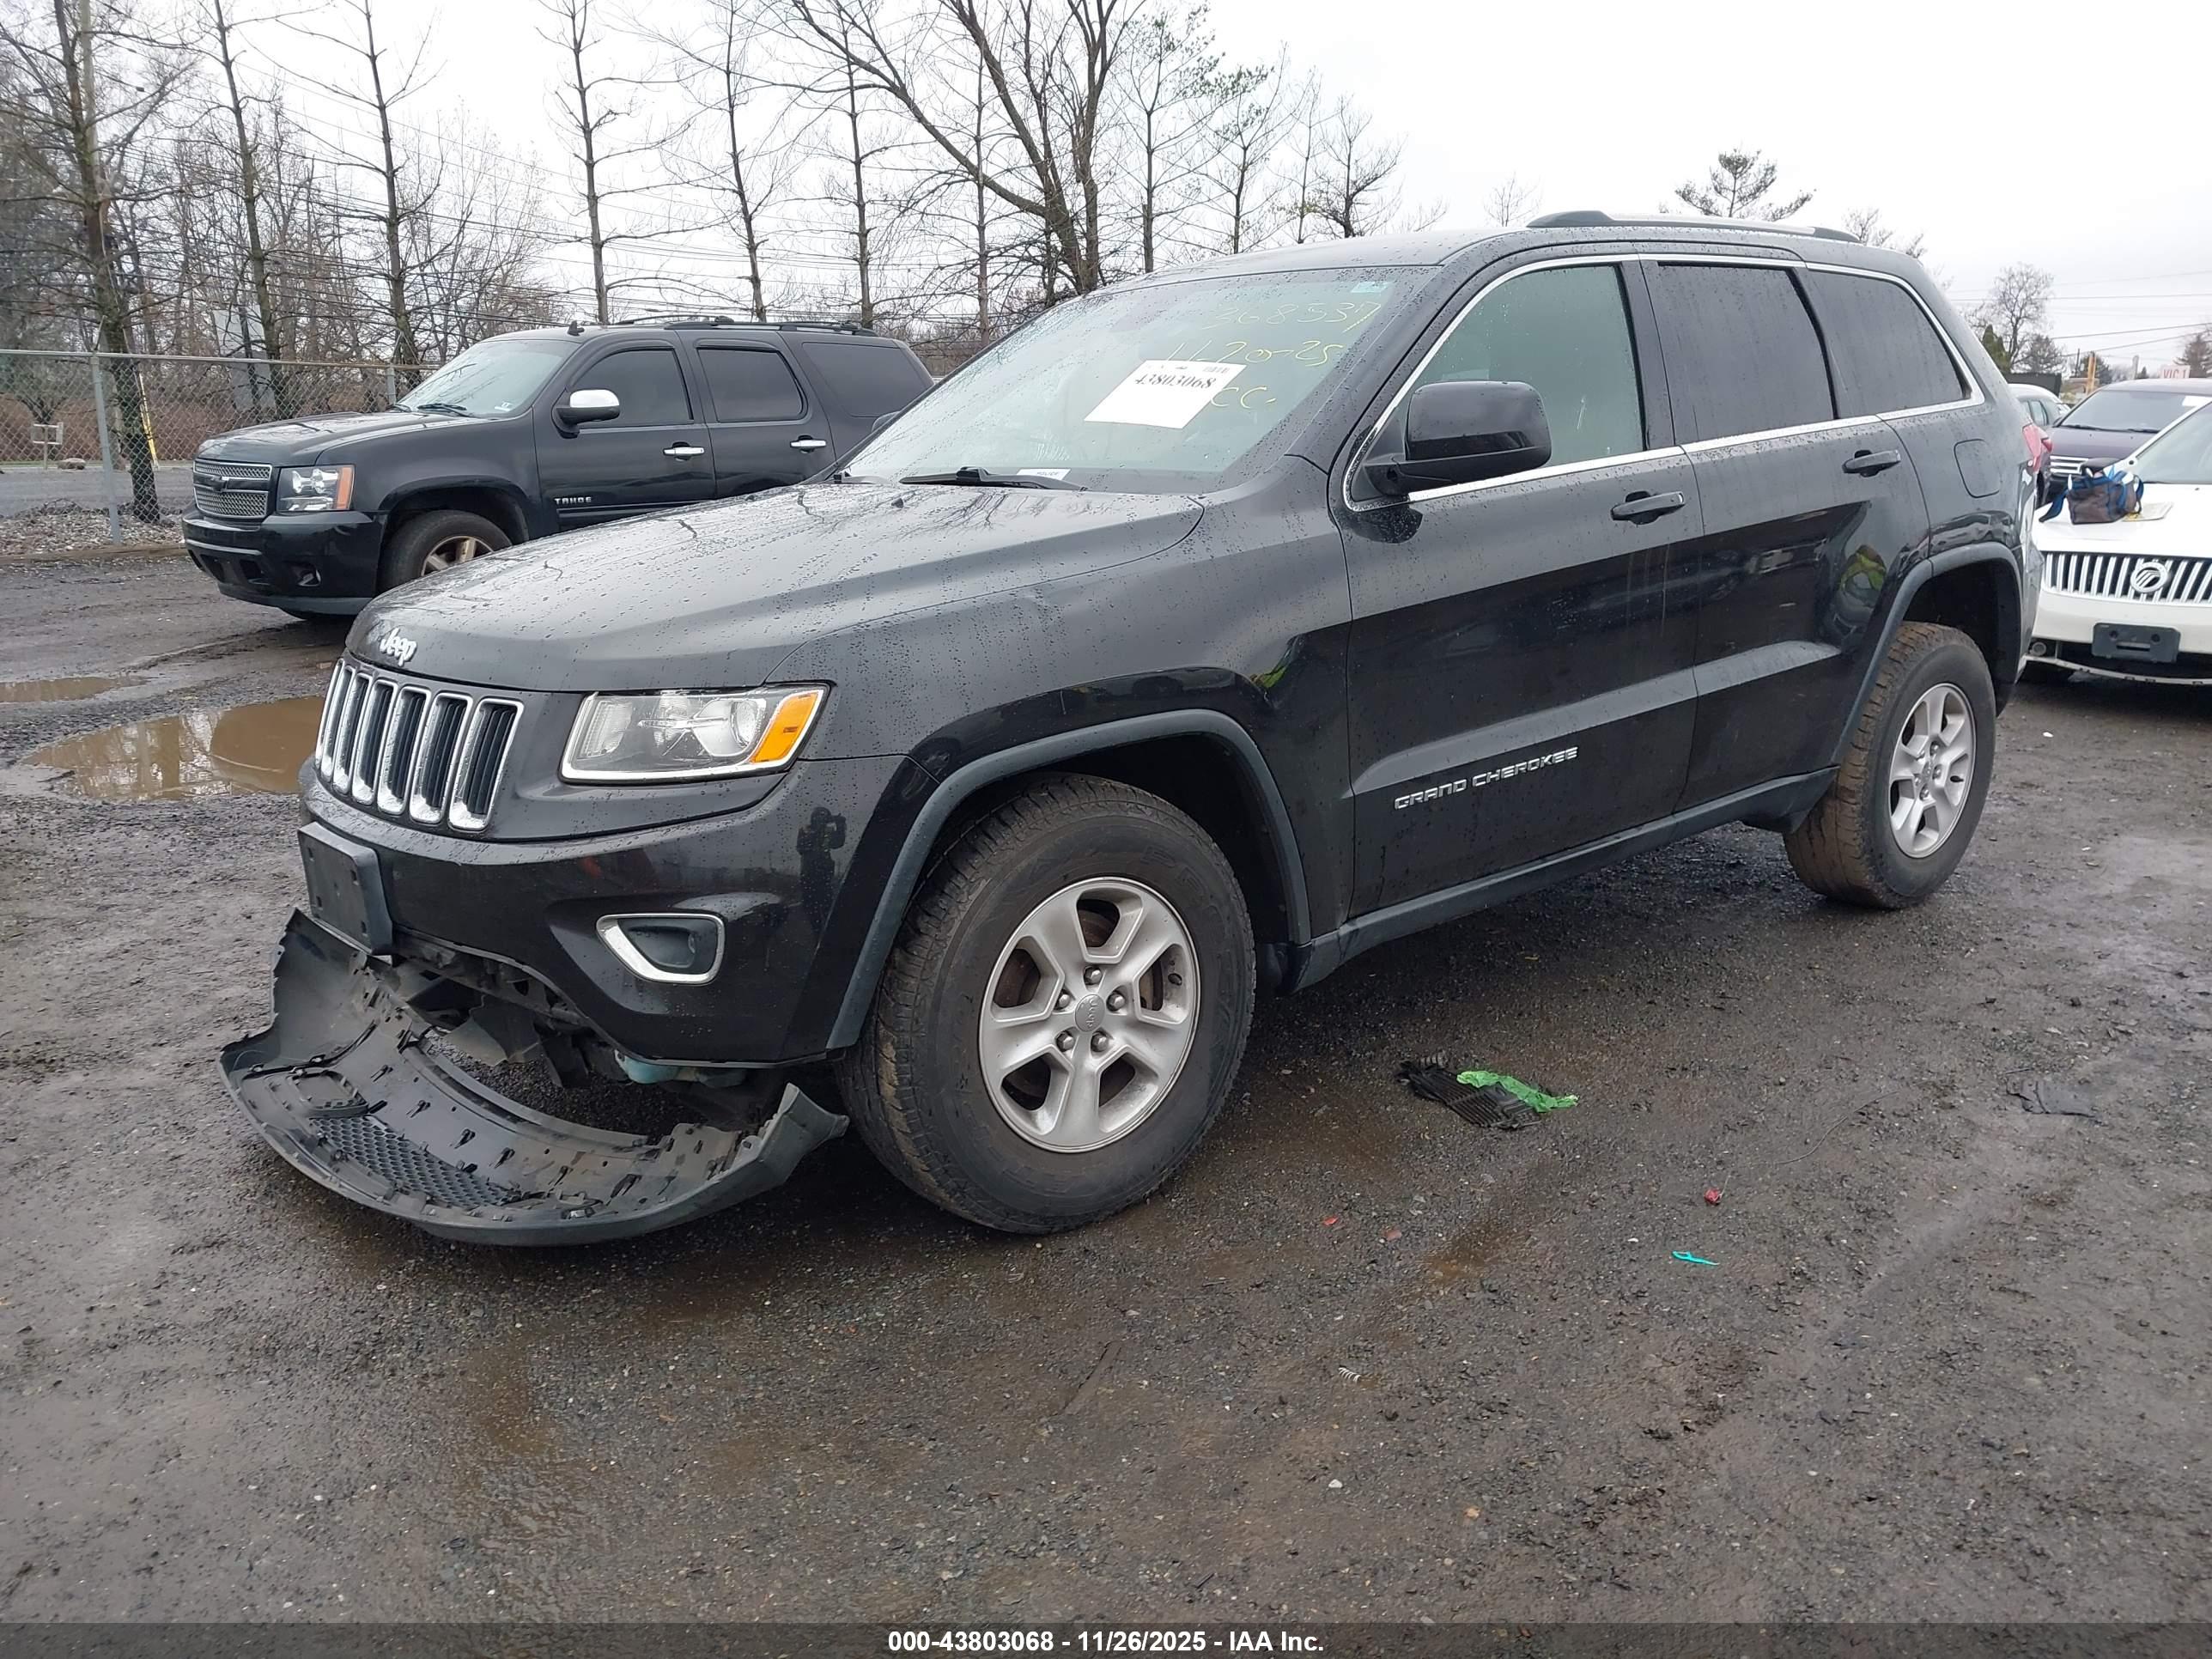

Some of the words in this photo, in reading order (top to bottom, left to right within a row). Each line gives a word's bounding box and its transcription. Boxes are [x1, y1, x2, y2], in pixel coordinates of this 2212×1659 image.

[1134, 373, 1217, 389] 43803068
[554, 496, 592, 505] TAHOE
[379, 627, 417, 667] Jeep
[1394, 778, 1468, 810] GRAND
[1472, 746, 1579, 787] CHEROKEE
